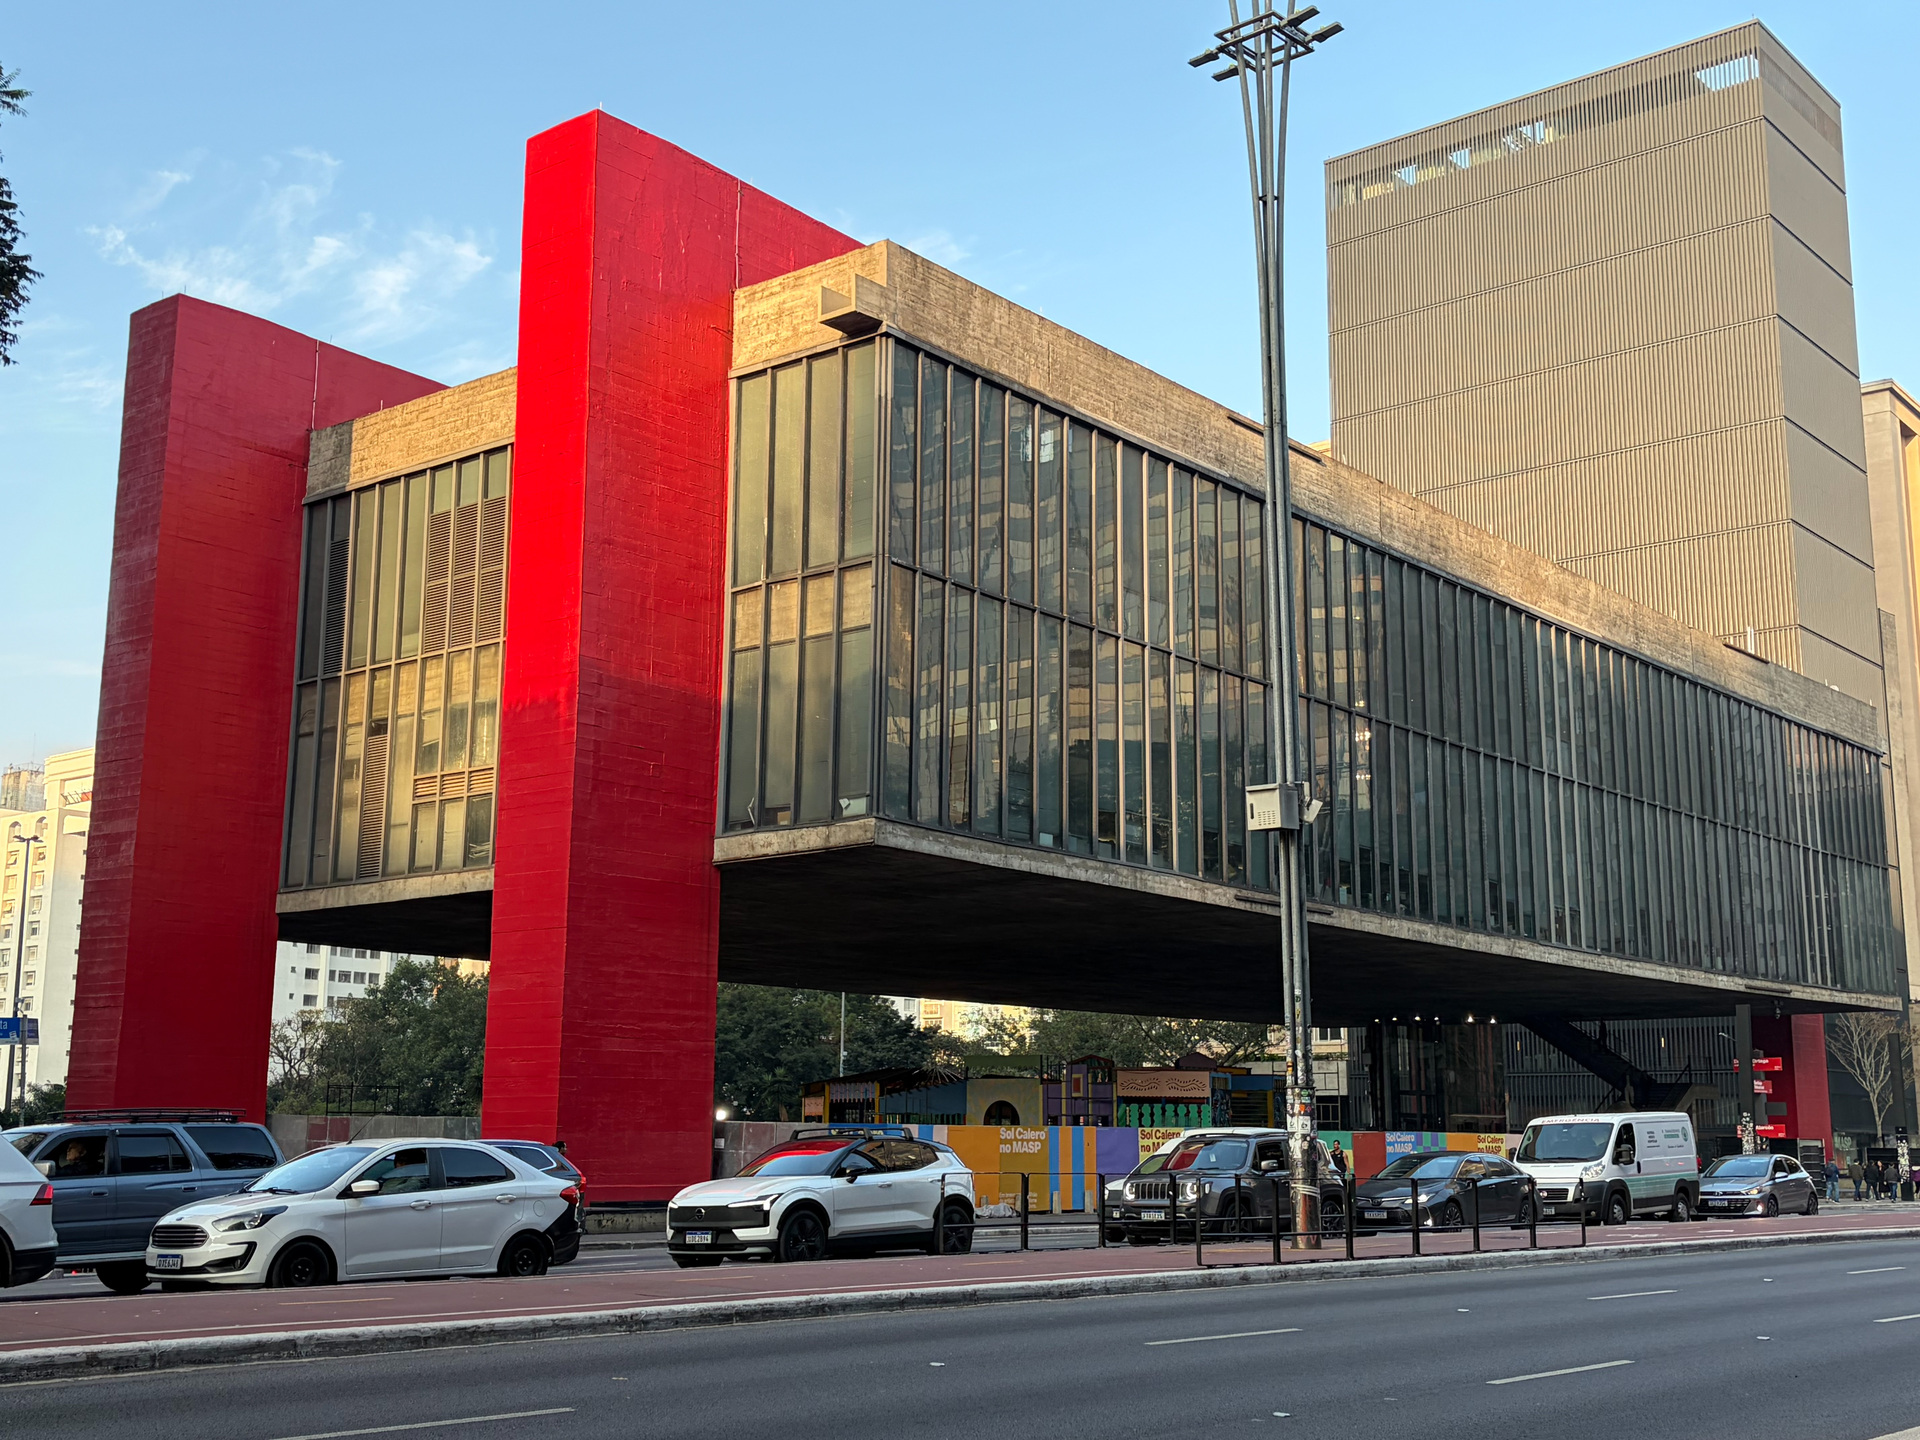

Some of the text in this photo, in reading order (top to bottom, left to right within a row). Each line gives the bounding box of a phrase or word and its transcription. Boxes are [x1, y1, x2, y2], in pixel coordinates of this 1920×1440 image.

[1000, 1127, 1046, 1140] Sol Calero
[1140, 1129, 1181, 1140] Sol Calero
[1385, 1132, 1415, 1142] Sol Calero
[1477, 1135, 1504, 1144] Sol Calero
[1000, 1141, 1041, 1153] no MASP
[1140, 1144, 1151, 1152] no
[1395, 1143, 1412, 1153] MASP
